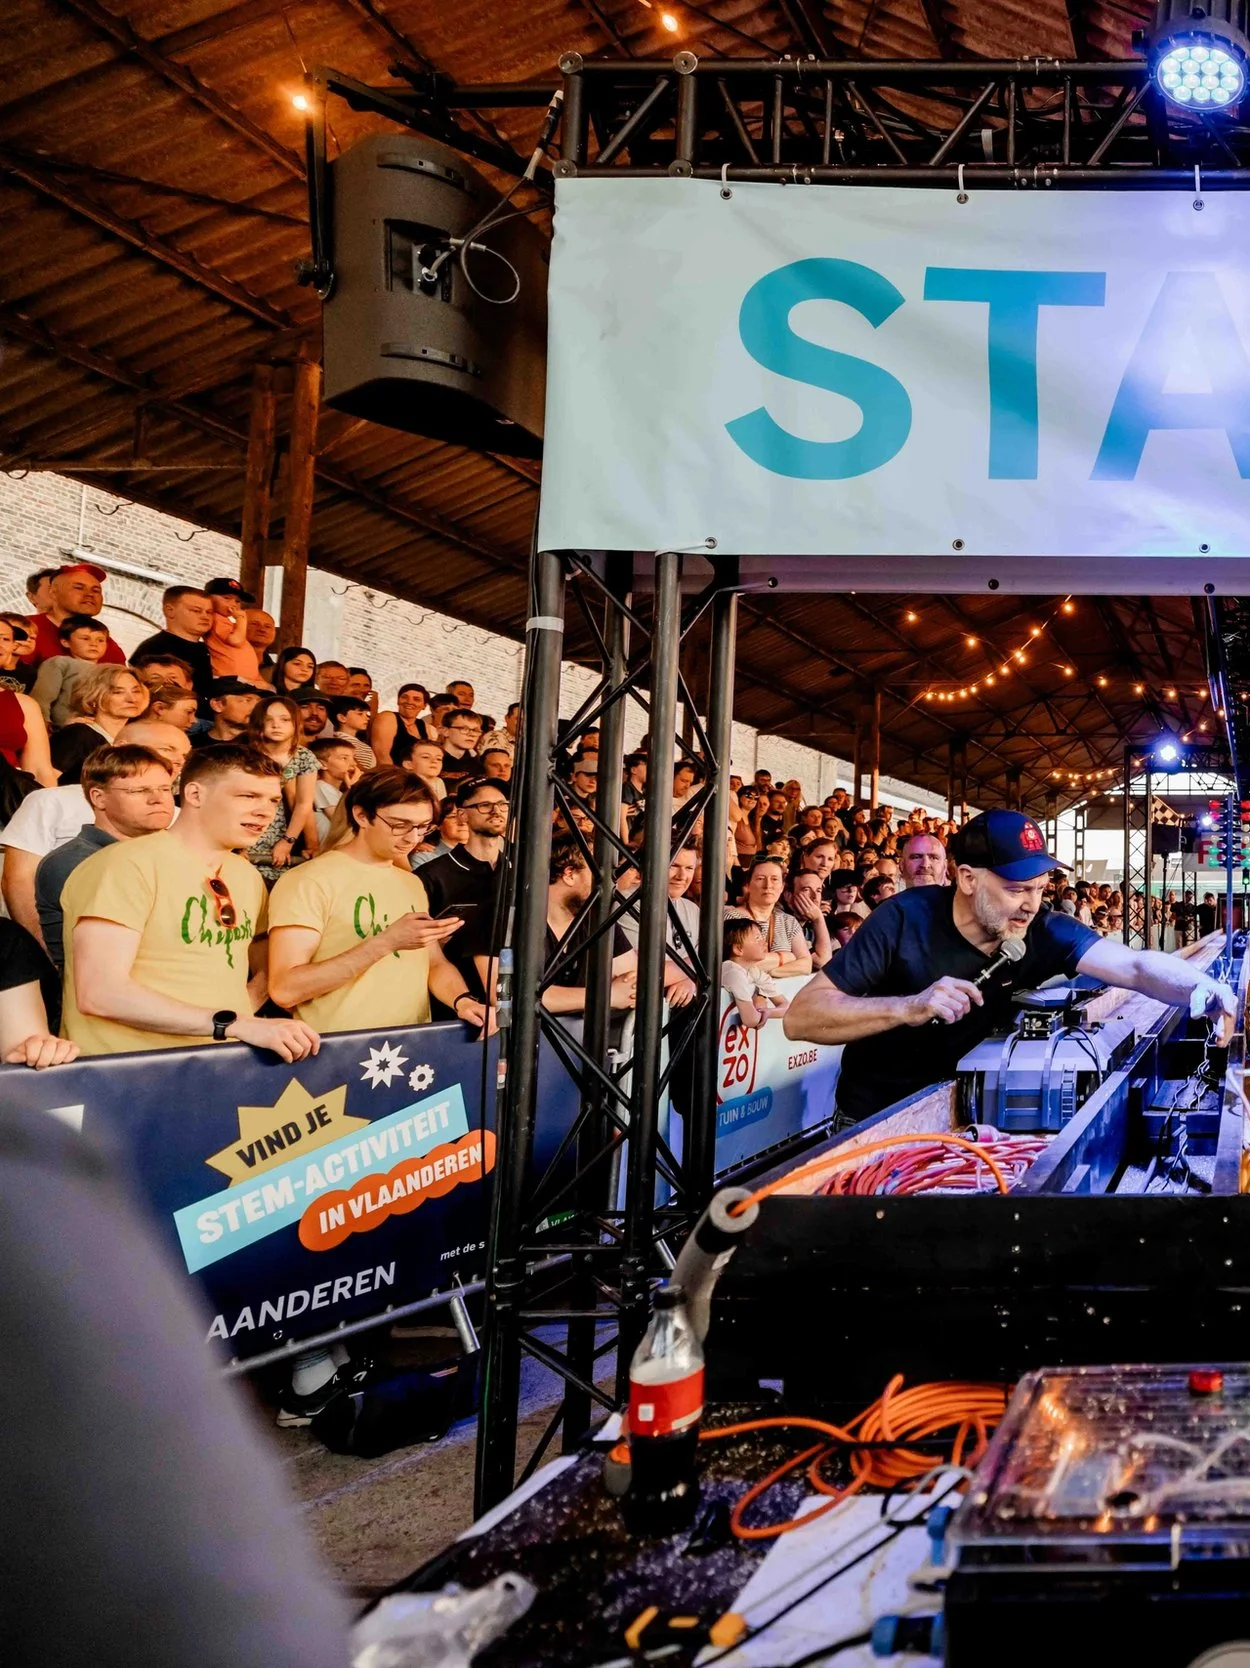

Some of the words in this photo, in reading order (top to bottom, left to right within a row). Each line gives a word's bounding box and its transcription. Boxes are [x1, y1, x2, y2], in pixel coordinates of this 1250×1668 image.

[788, 1048, 818, 1071] EXZO.BE
[719, 1107, 739, 1127] TUIN
[740, 1104, 746, 1119] &
[747, 1095, 769, 1116] BOUW
[235, 1121, 302, 1168] VIND
[302, 1103, 333, 1135] JE
[196, 1100, 450, 1244] STEM-ACTIVITEIT
[319, 1207, 346, 1235] IN
[348, 1142, 482, 1219] VLAANDEREN
[440, 1246, 460, 1261] met
[463, 1243, 476, 1254] de
